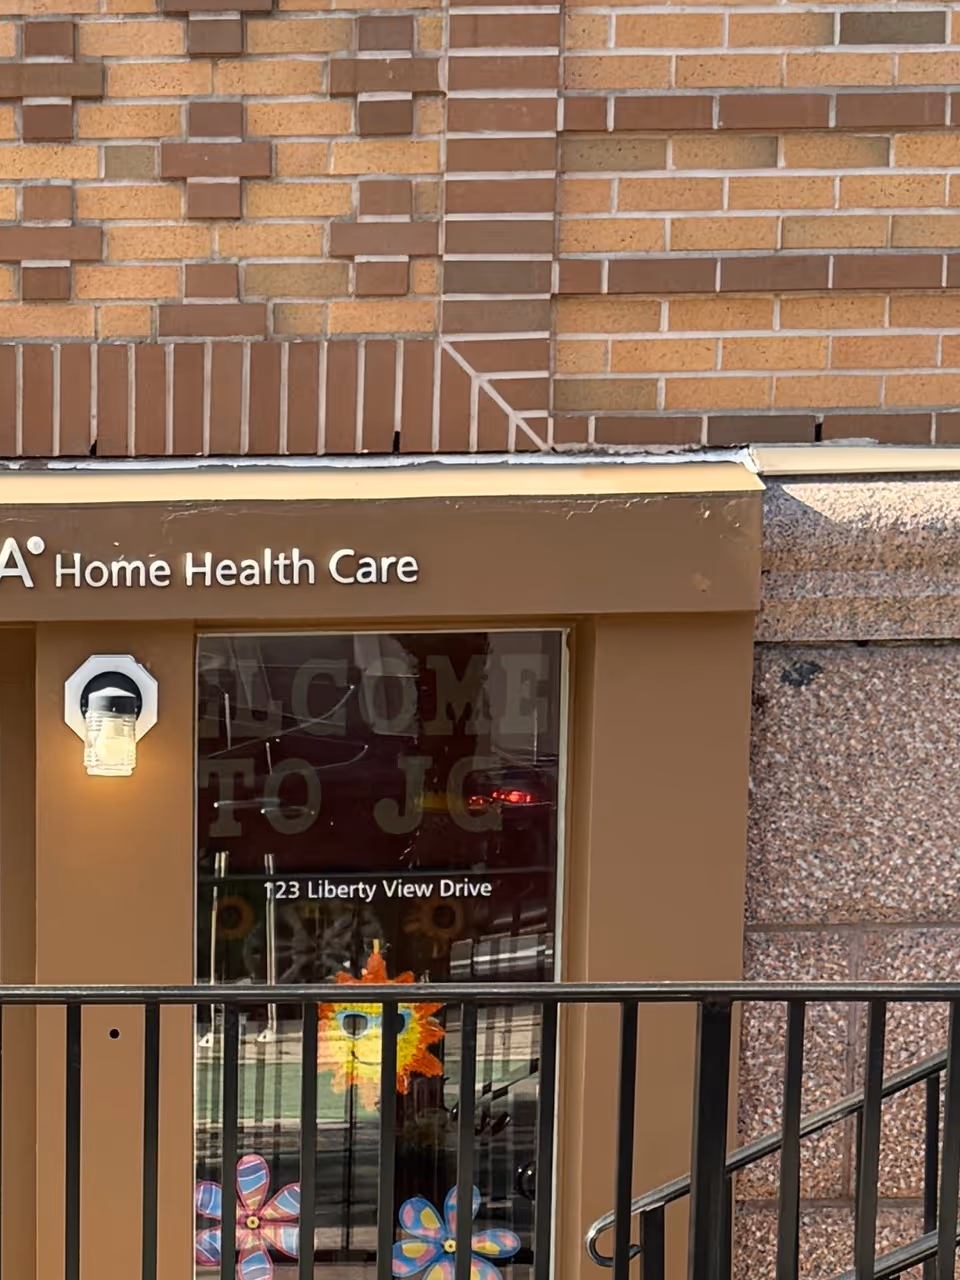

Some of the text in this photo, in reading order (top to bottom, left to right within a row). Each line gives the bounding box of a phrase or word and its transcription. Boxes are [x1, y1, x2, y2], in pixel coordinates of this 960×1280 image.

[55, 552, 171, 587] Home
[185, 547, 315, 586] Health
[328, 548, 419, 584] Care
[199, 756, 322, 837] TO
[264, 879, 492, 903] 123 Liberty View Drive
